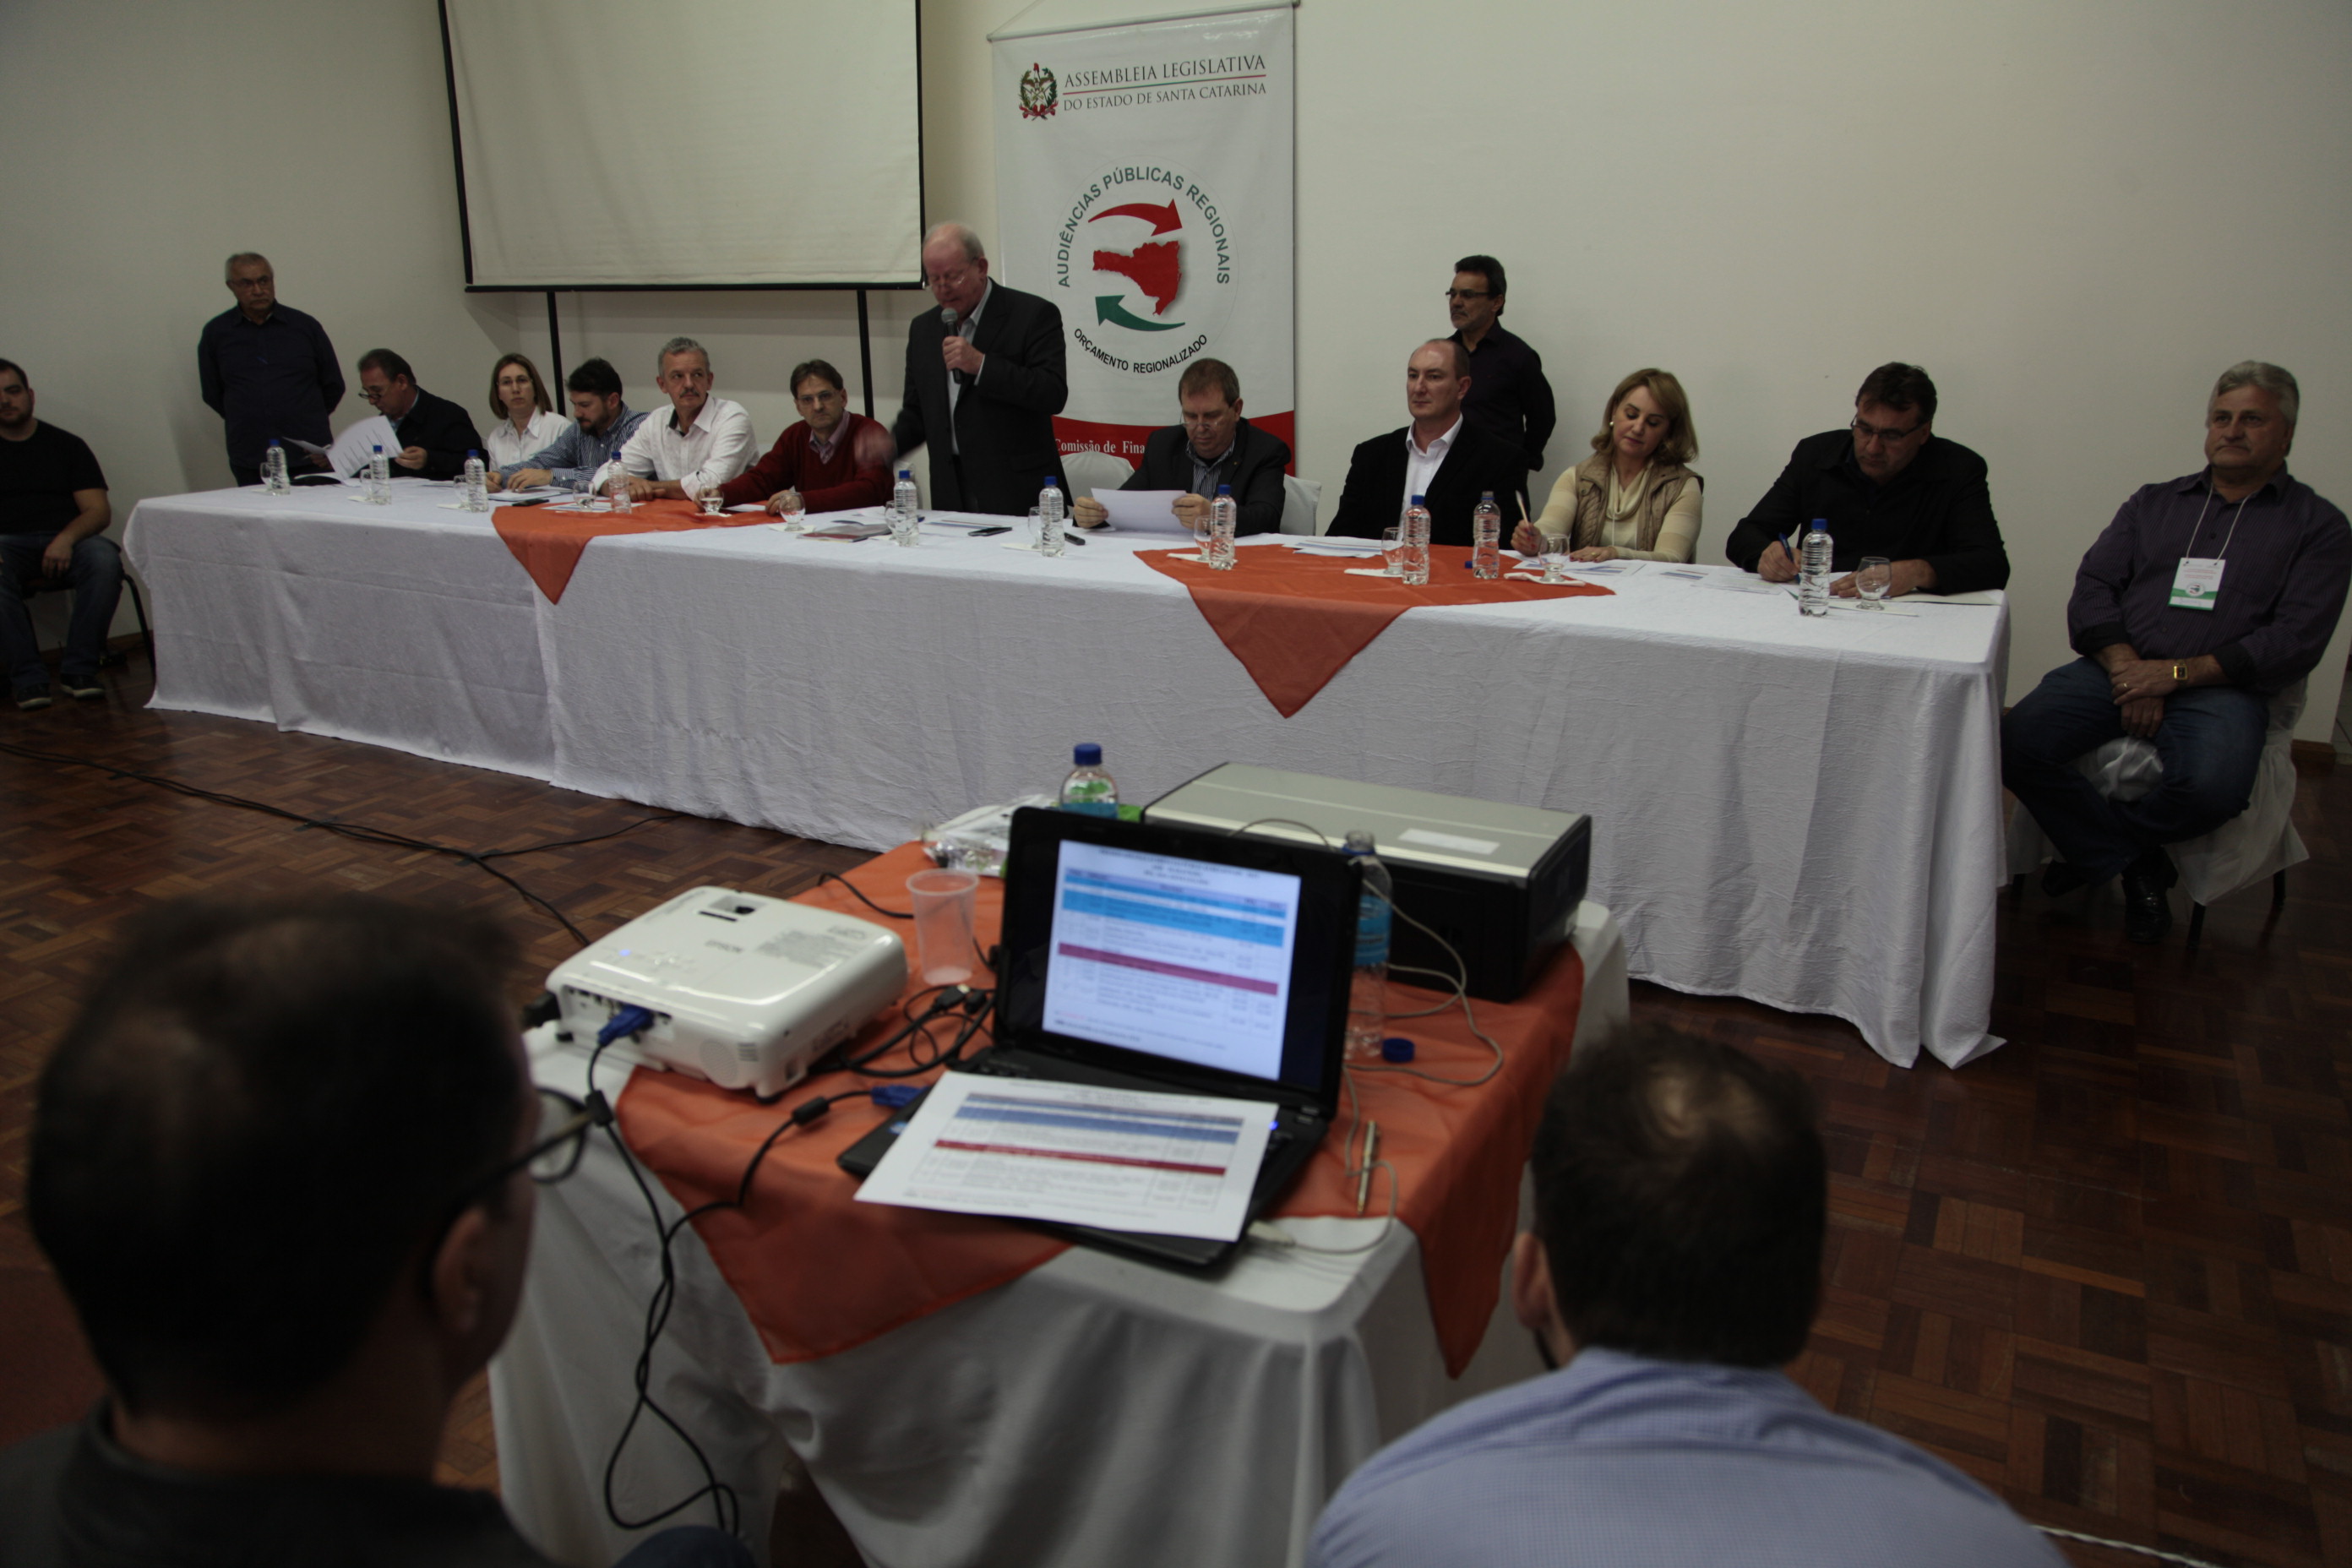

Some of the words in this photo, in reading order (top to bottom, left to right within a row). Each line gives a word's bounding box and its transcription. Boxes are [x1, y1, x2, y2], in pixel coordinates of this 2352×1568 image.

[1064, 65, 1157, 88] ASSEMBLEIA
[1162, 54, 1266, 79] LEGISLATIVA
[1064, 98, 1082, 112] DO
[1086, 93, 1133, 110] ESTADO
[1137, 92, 1152, 105] DE
[1156, 88, 1195, 103] SANTA
[1200, 82, 1266, 99] CATARINA
[1057, 183, 1102, 288] AUDIÊNCIAS
[1102, 166, 1184, 191] PÚBLICAS
[1186, 183, 1230, 285] REGIONAIS
[1074, 328, 1129, 371] ORÇAMENTO
[1133, 334, 1208, 373] REGIONALIZADO
[1103, 440, 1116, 453] de
